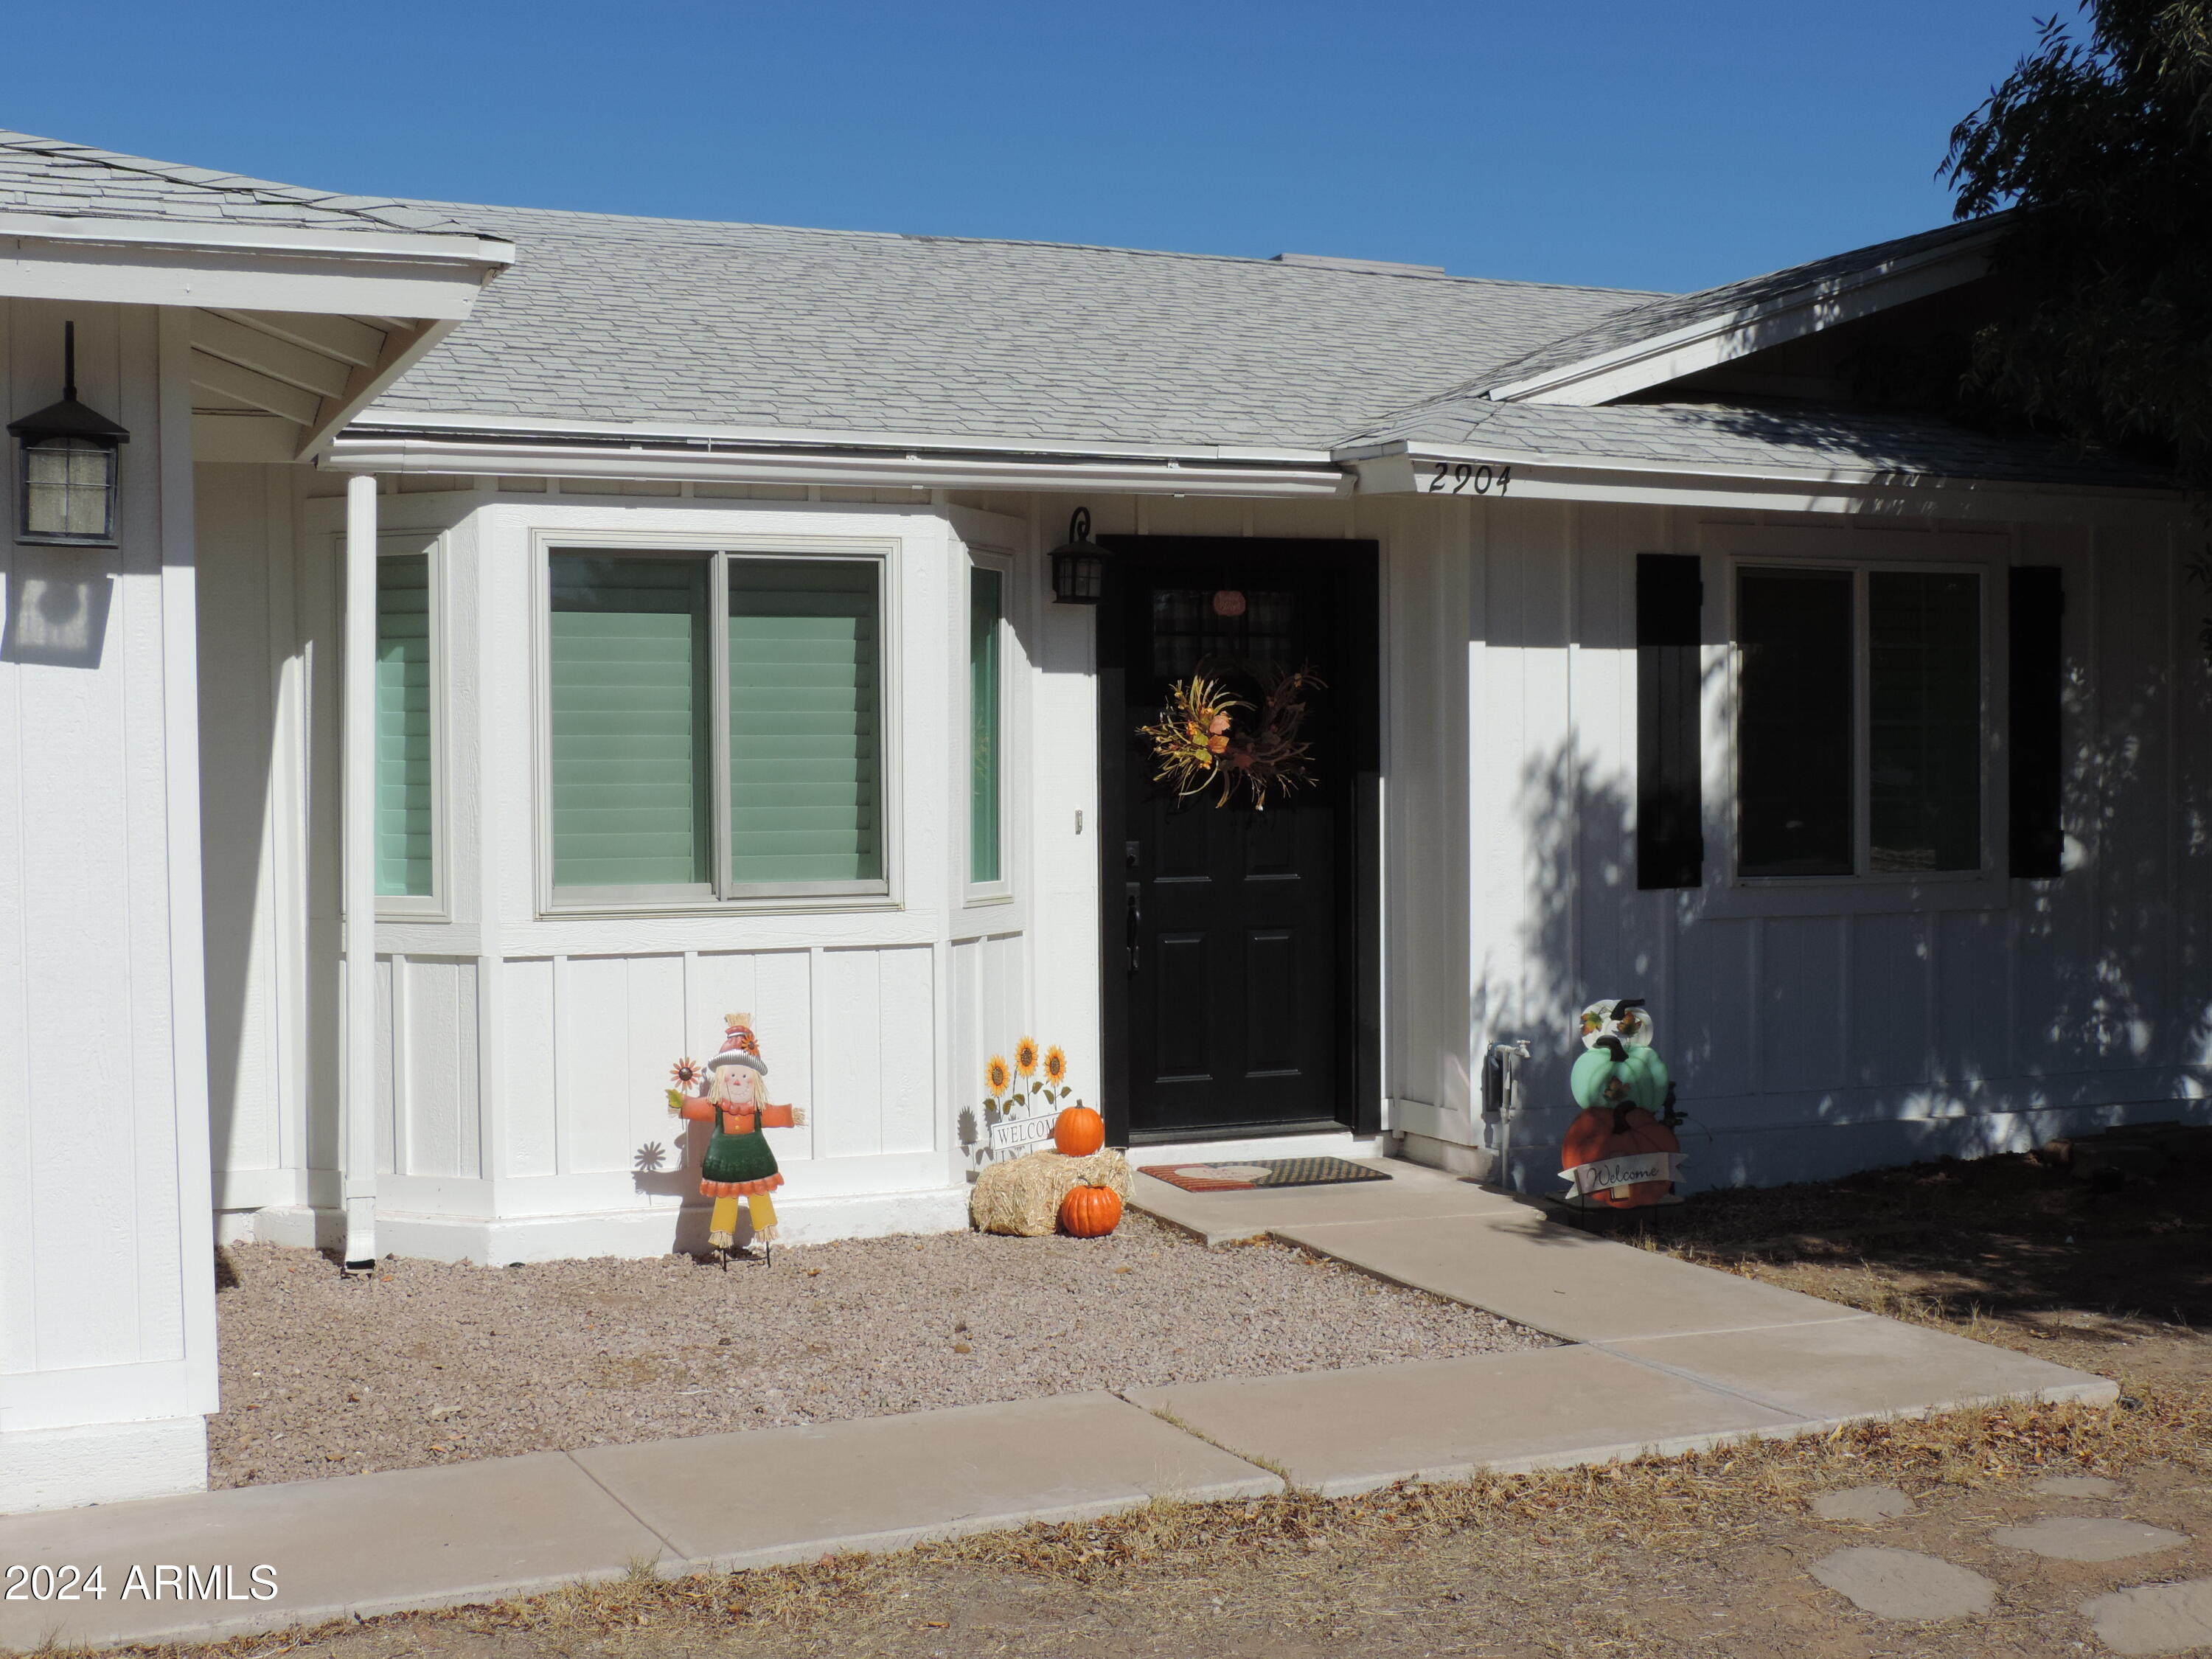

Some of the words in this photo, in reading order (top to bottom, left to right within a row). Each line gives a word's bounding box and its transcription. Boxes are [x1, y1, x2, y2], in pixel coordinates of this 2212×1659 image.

[1429, 462, 1511, 497] 2904
[997, 1118, 1055, 1145] WELCOM
[1586, 1164, 1659, 1188] Welcome
